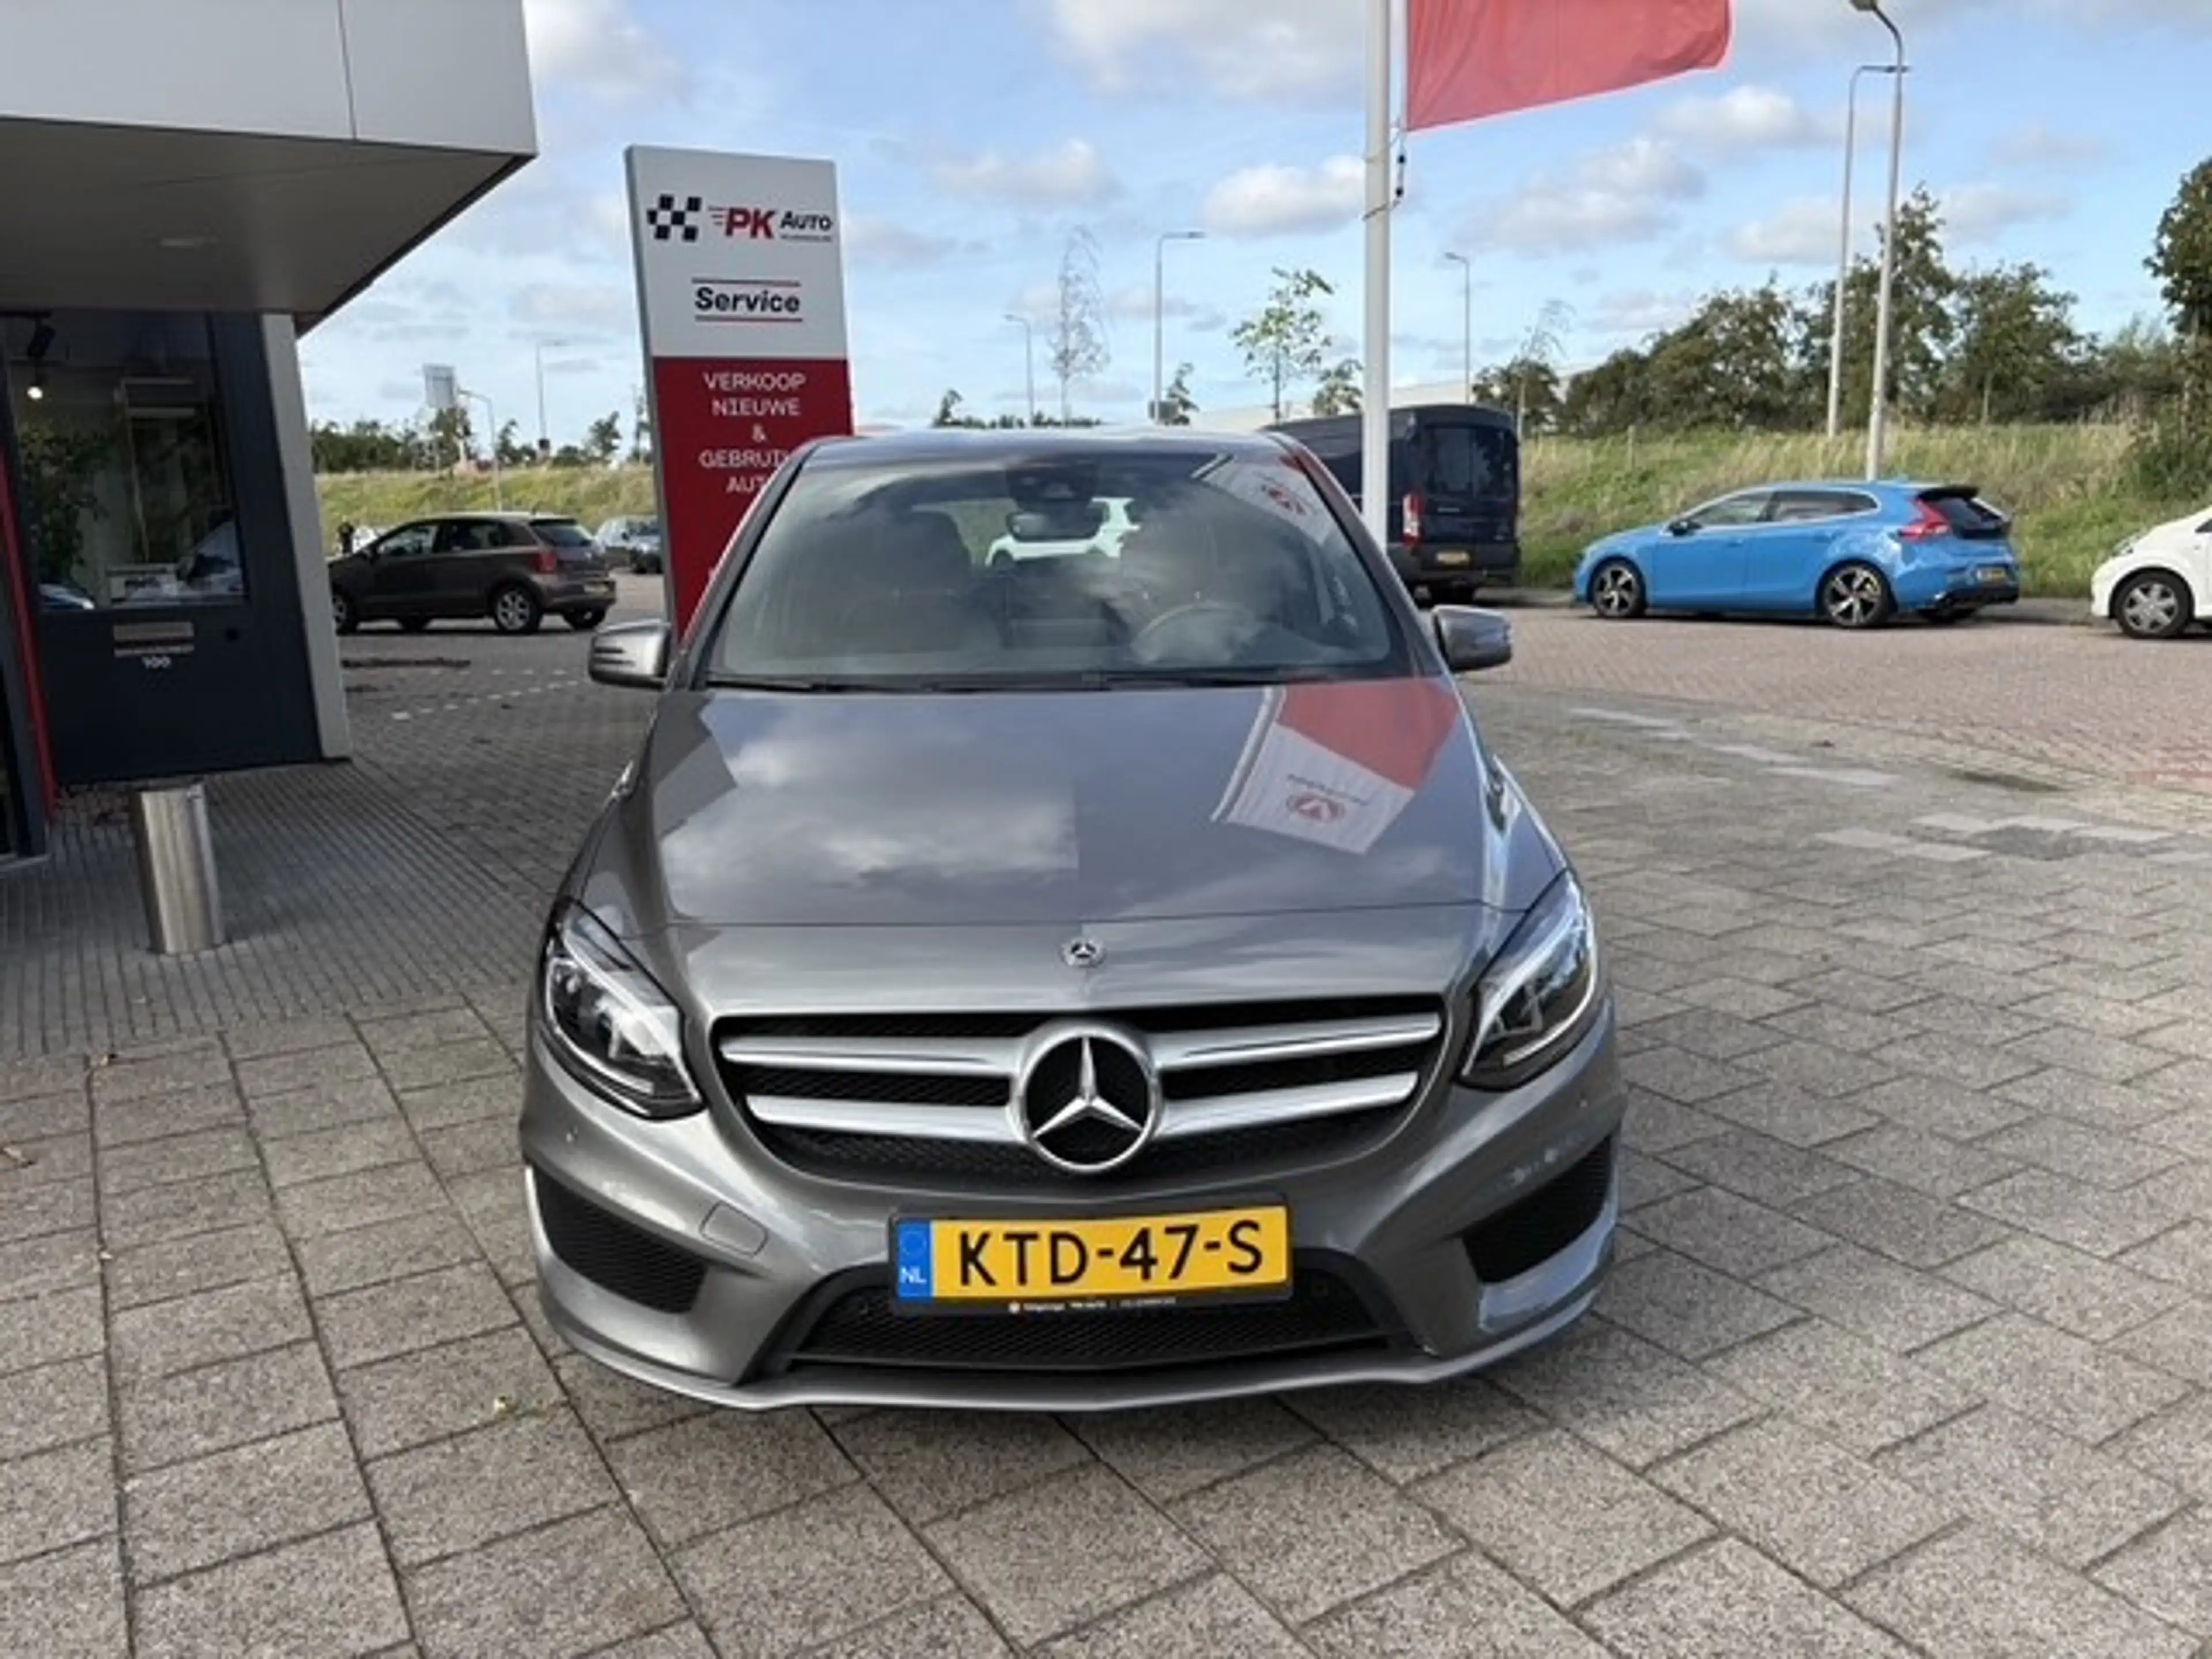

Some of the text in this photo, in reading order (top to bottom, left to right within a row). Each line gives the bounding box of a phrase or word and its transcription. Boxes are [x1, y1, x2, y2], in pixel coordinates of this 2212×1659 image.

[725, 207, 778, 240] PK
[695, 286, 801, 313] Service
[703, 372, 806, 391] VERKOOP
[712, 398, 801, 416] NIEUWE
[751, 424, 766, 443] &
[698, 448, 790, 469] GEBRUI
[959, 1219, 1263, 1287] KTD-47-S
[900, 1266, 927, 1284] NL
